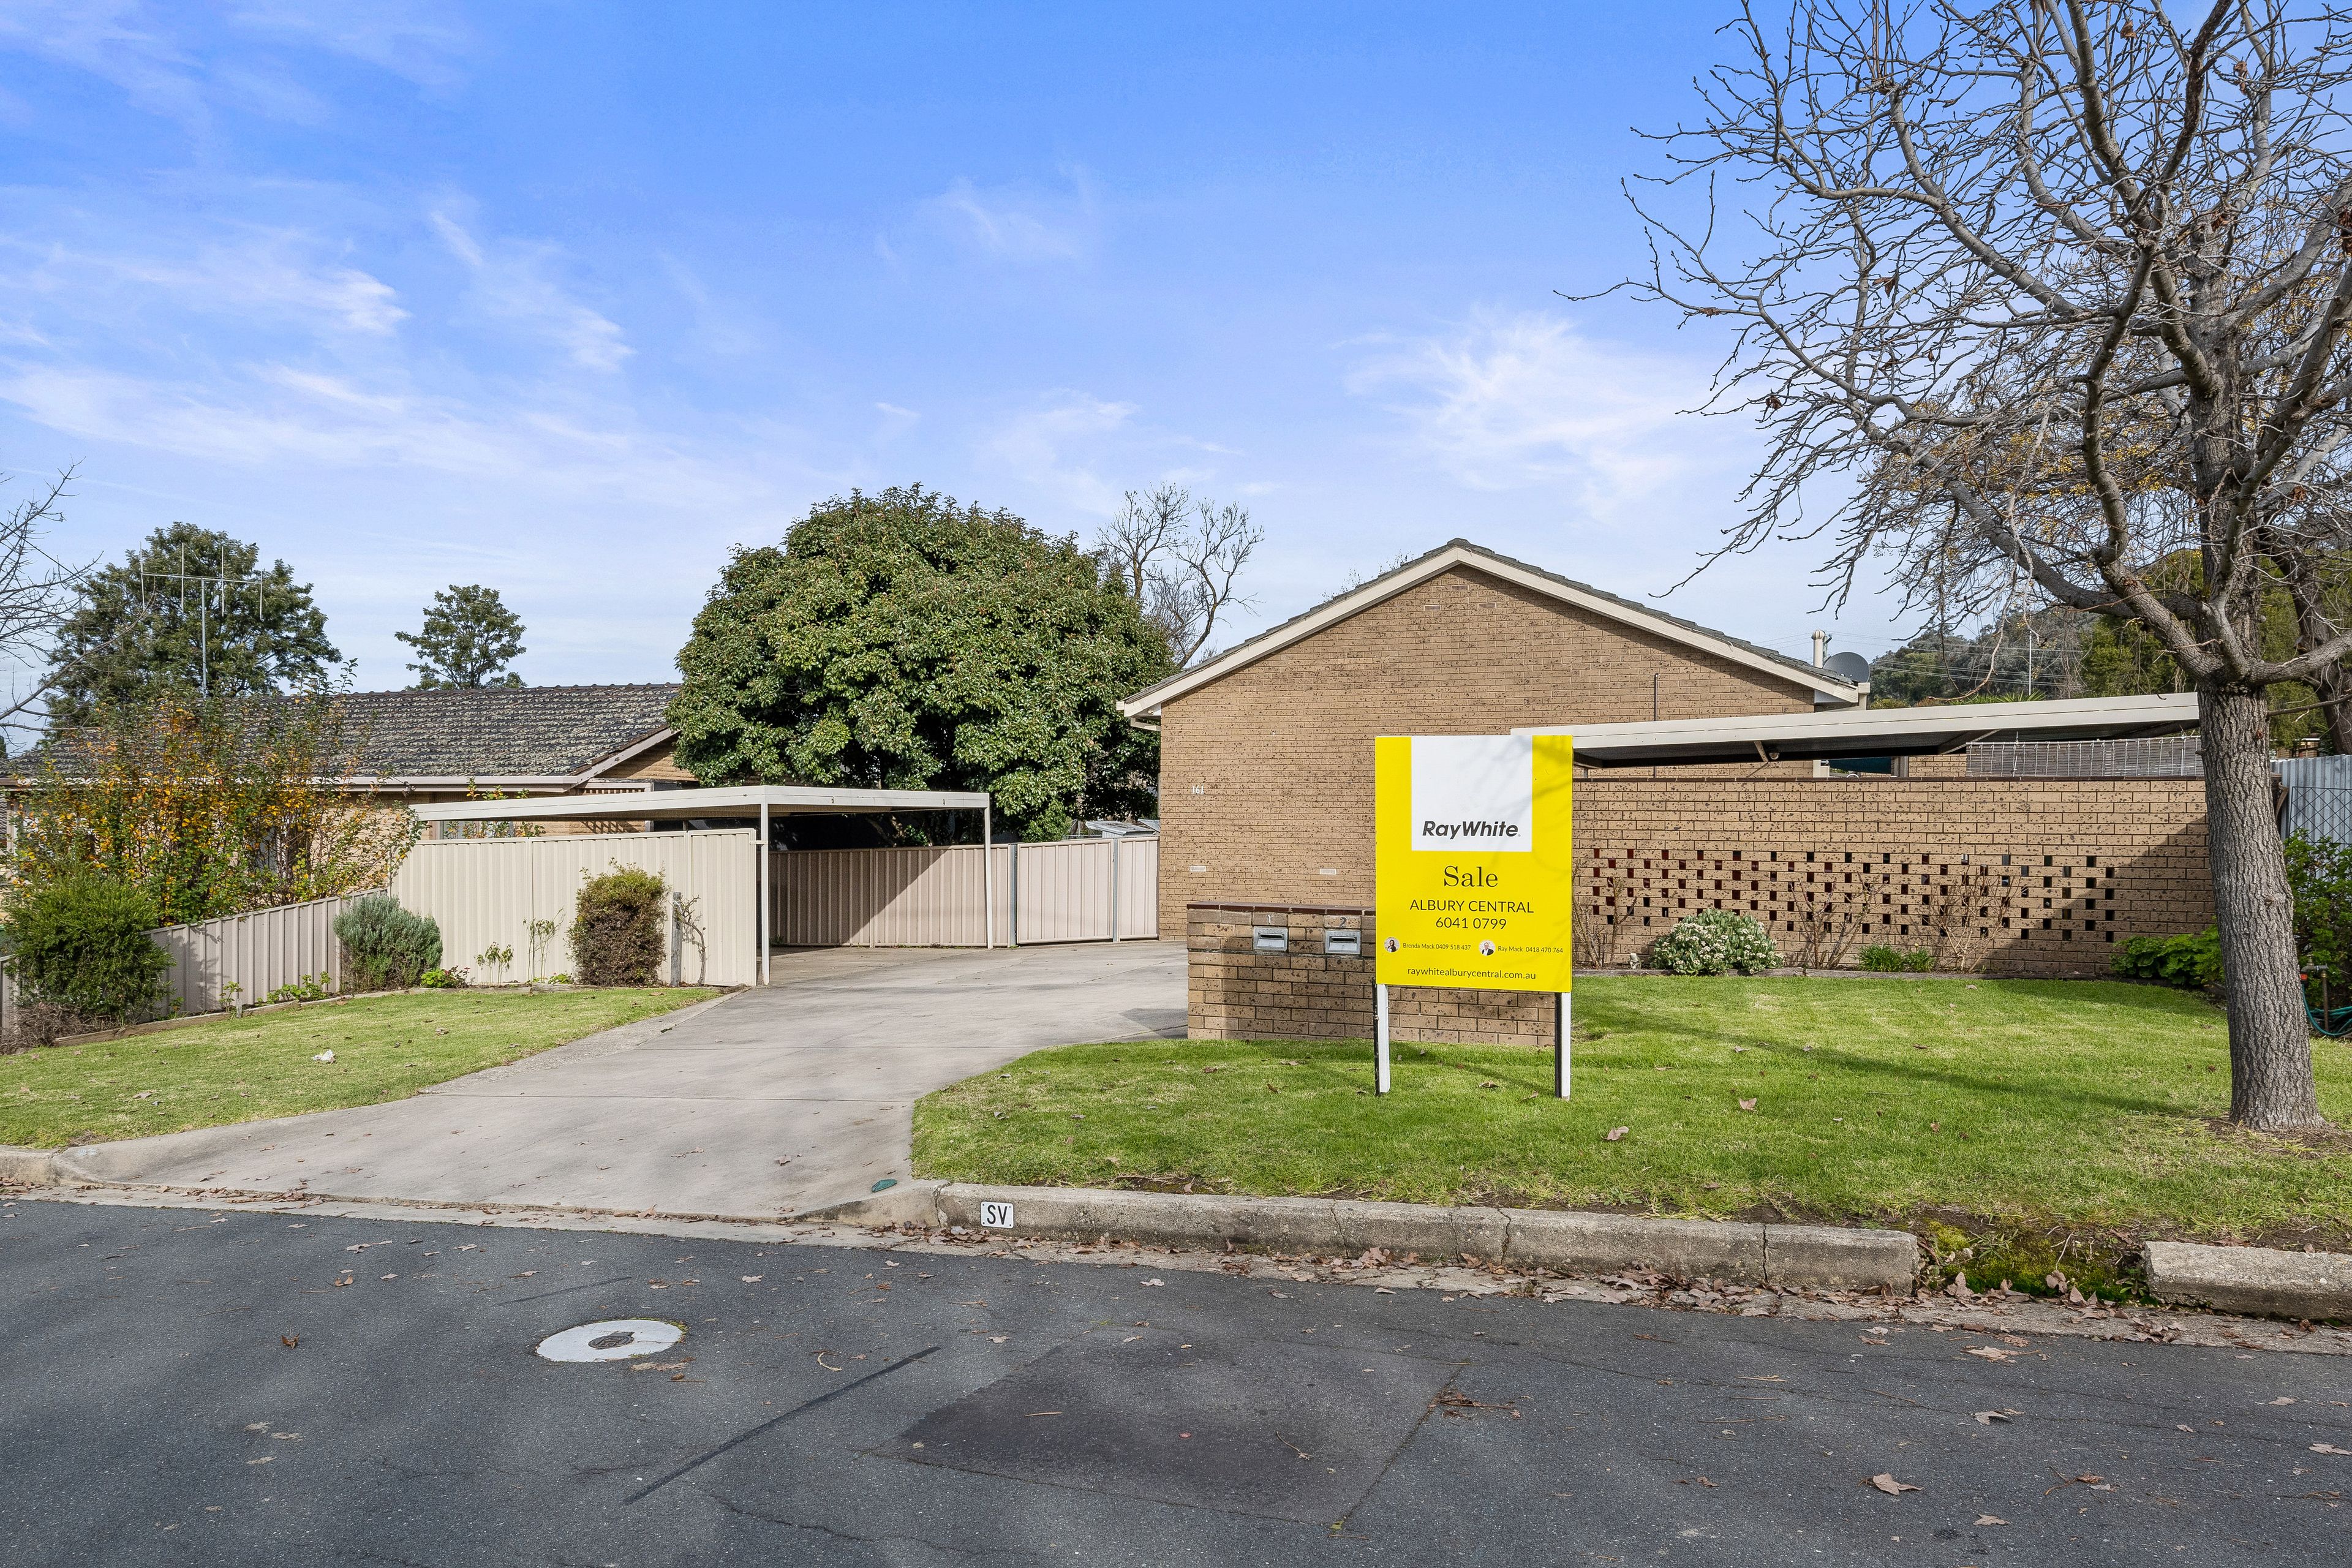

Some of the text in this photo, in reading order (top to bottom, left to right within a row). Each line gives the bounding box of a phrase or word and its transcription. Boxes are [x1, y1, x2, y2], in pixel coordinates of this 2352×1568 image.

[1444, 865, 1498, 888] Sale
[1409, 899, 1534, 913] ALBURY CENTRAL
[1340, 916, 1347, 928] 2
[1436, 917, 1507, 930] 6041 0799
[1408, 967, 1537, 980] raywhitealburycentral.com.au
[987, 1204, 1008, 1225] SV
